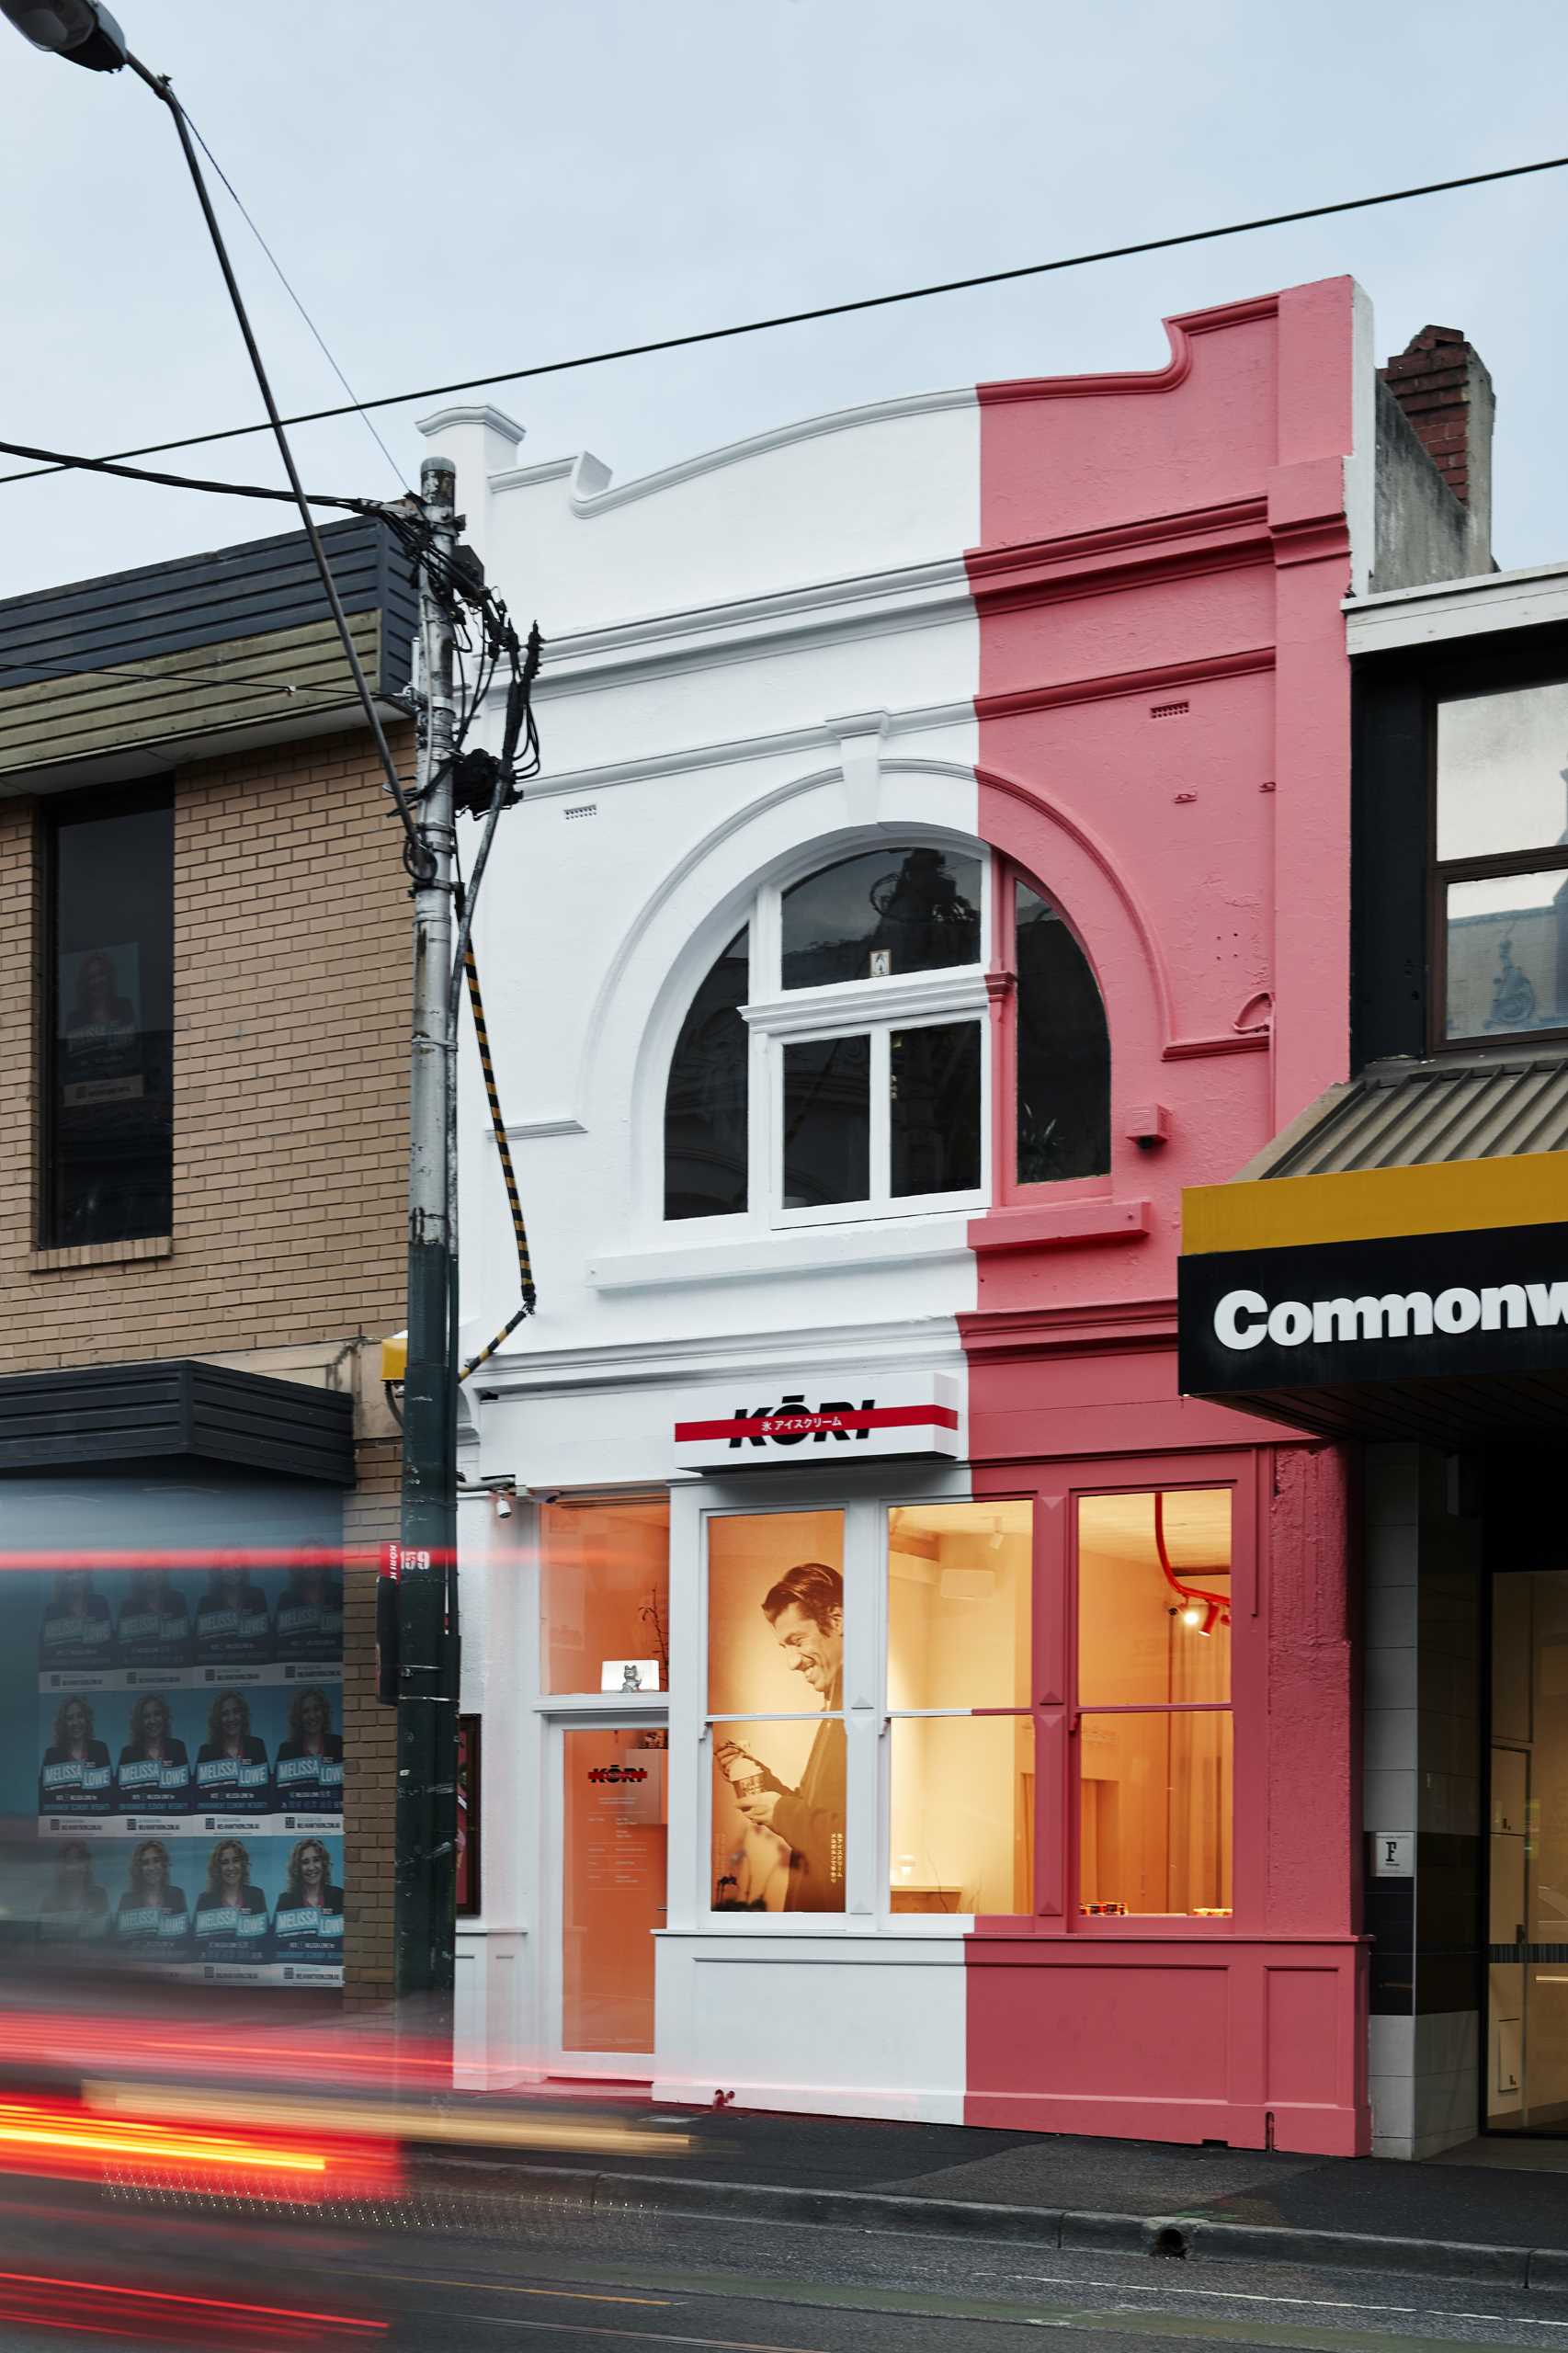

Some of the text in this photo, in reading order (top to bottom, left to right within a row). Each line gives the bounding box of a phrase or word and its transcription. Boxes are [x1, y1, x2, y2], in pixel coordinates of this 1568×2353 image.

[774, 1415, 843, 1431] アイスクリーム
[46, 1764, 82, 1782] MELISSA
[120, 1762, 160, 1781] MELISSA
[199, 1760, 238, 1780] MELISSA
[278, 1758, 344, 1783] MELISSA LOW
[278, 1909, 345, 1934] MELISSA LOW
